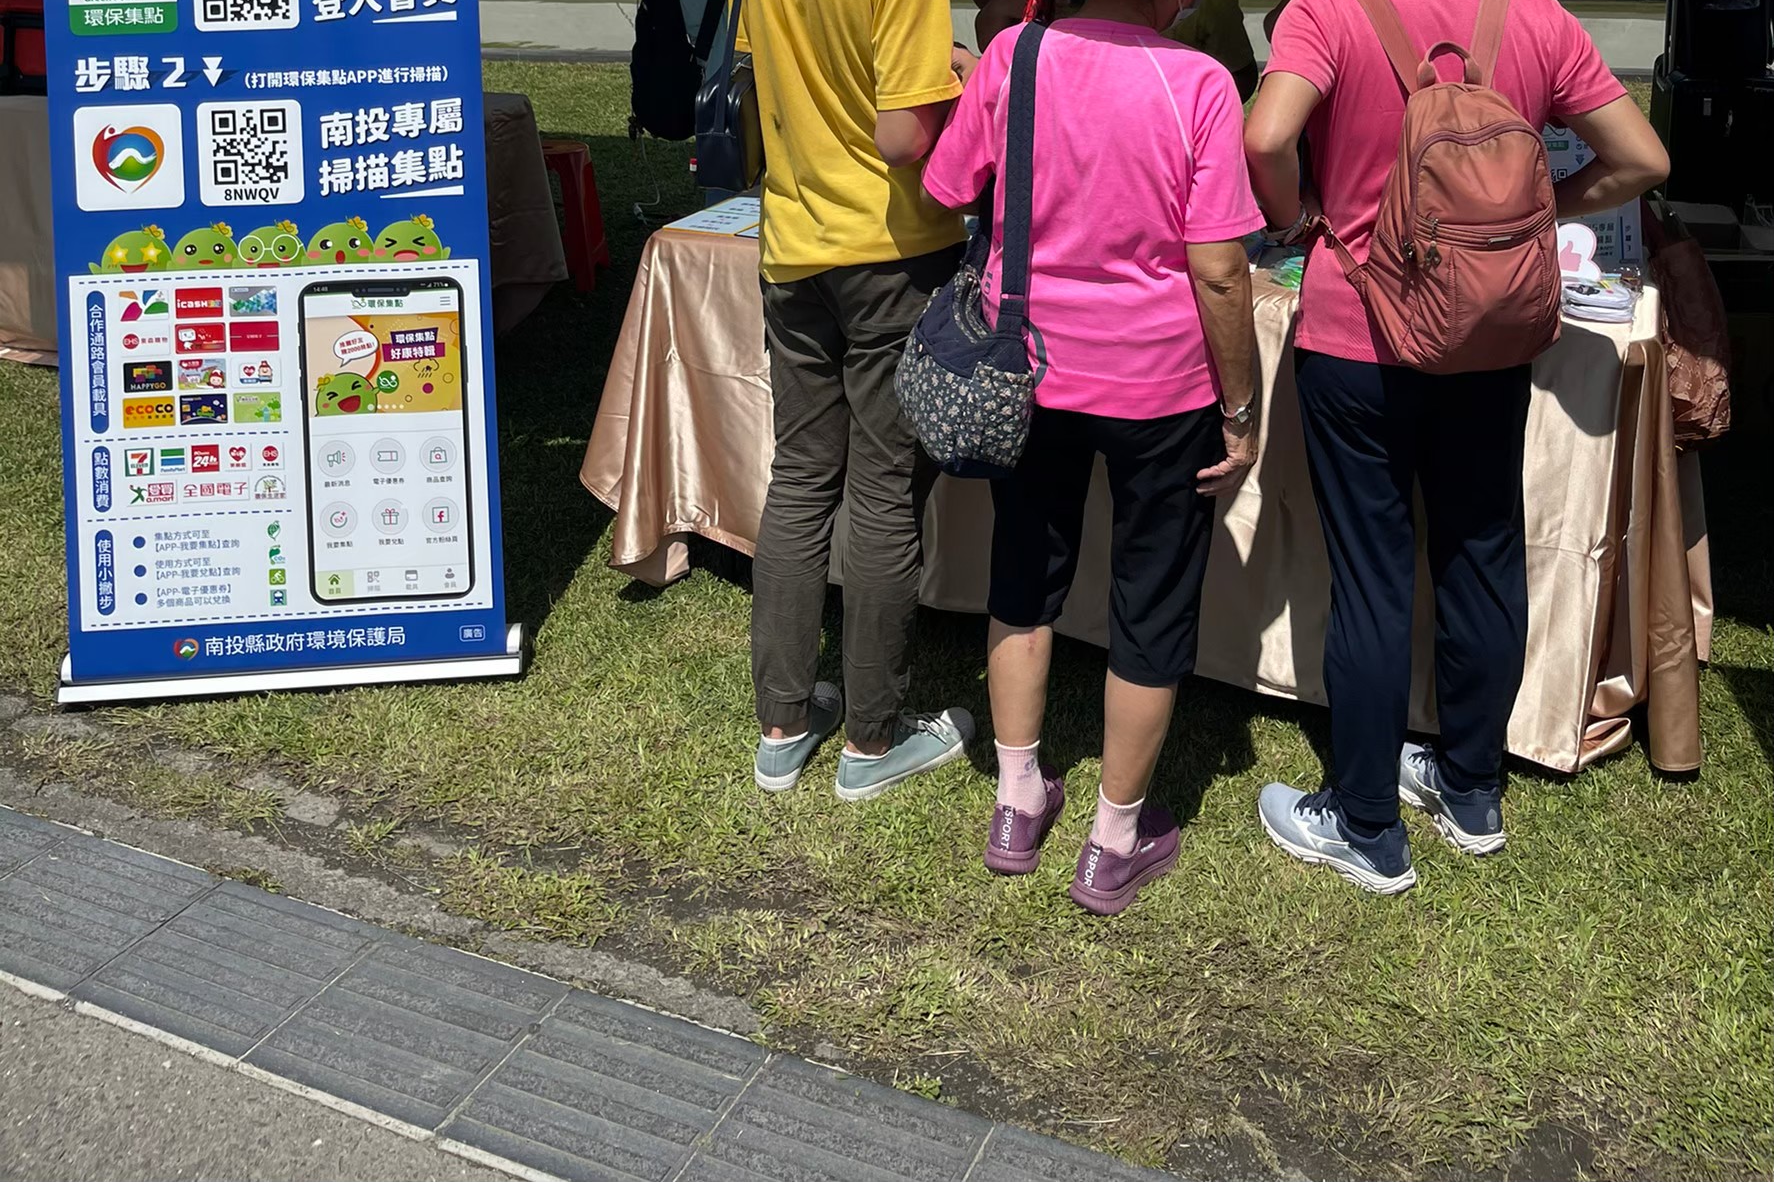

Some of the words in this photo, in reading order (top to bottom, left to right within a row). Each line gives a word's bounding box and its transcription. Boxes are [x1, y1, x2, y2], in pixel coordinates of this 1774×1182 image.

[84, 7, 164, 27] 環保集點
[75, 55, 150, 93] 步驟
[319, 97, 463, 149] 南投專屬
[319, 143, 464, 197] 掃描集點
[224, 186, 280, 202] 8NWQV
[89, 304, 107, 416] 合作通路會員載具
[93, 452, 110, 508] 點數消費
[184, 482, 248, 498] 全國電子
[97, 539, 114, 610] 使用小撇步
[205, 626, 406, 657] 南投縣政府環境保護局
